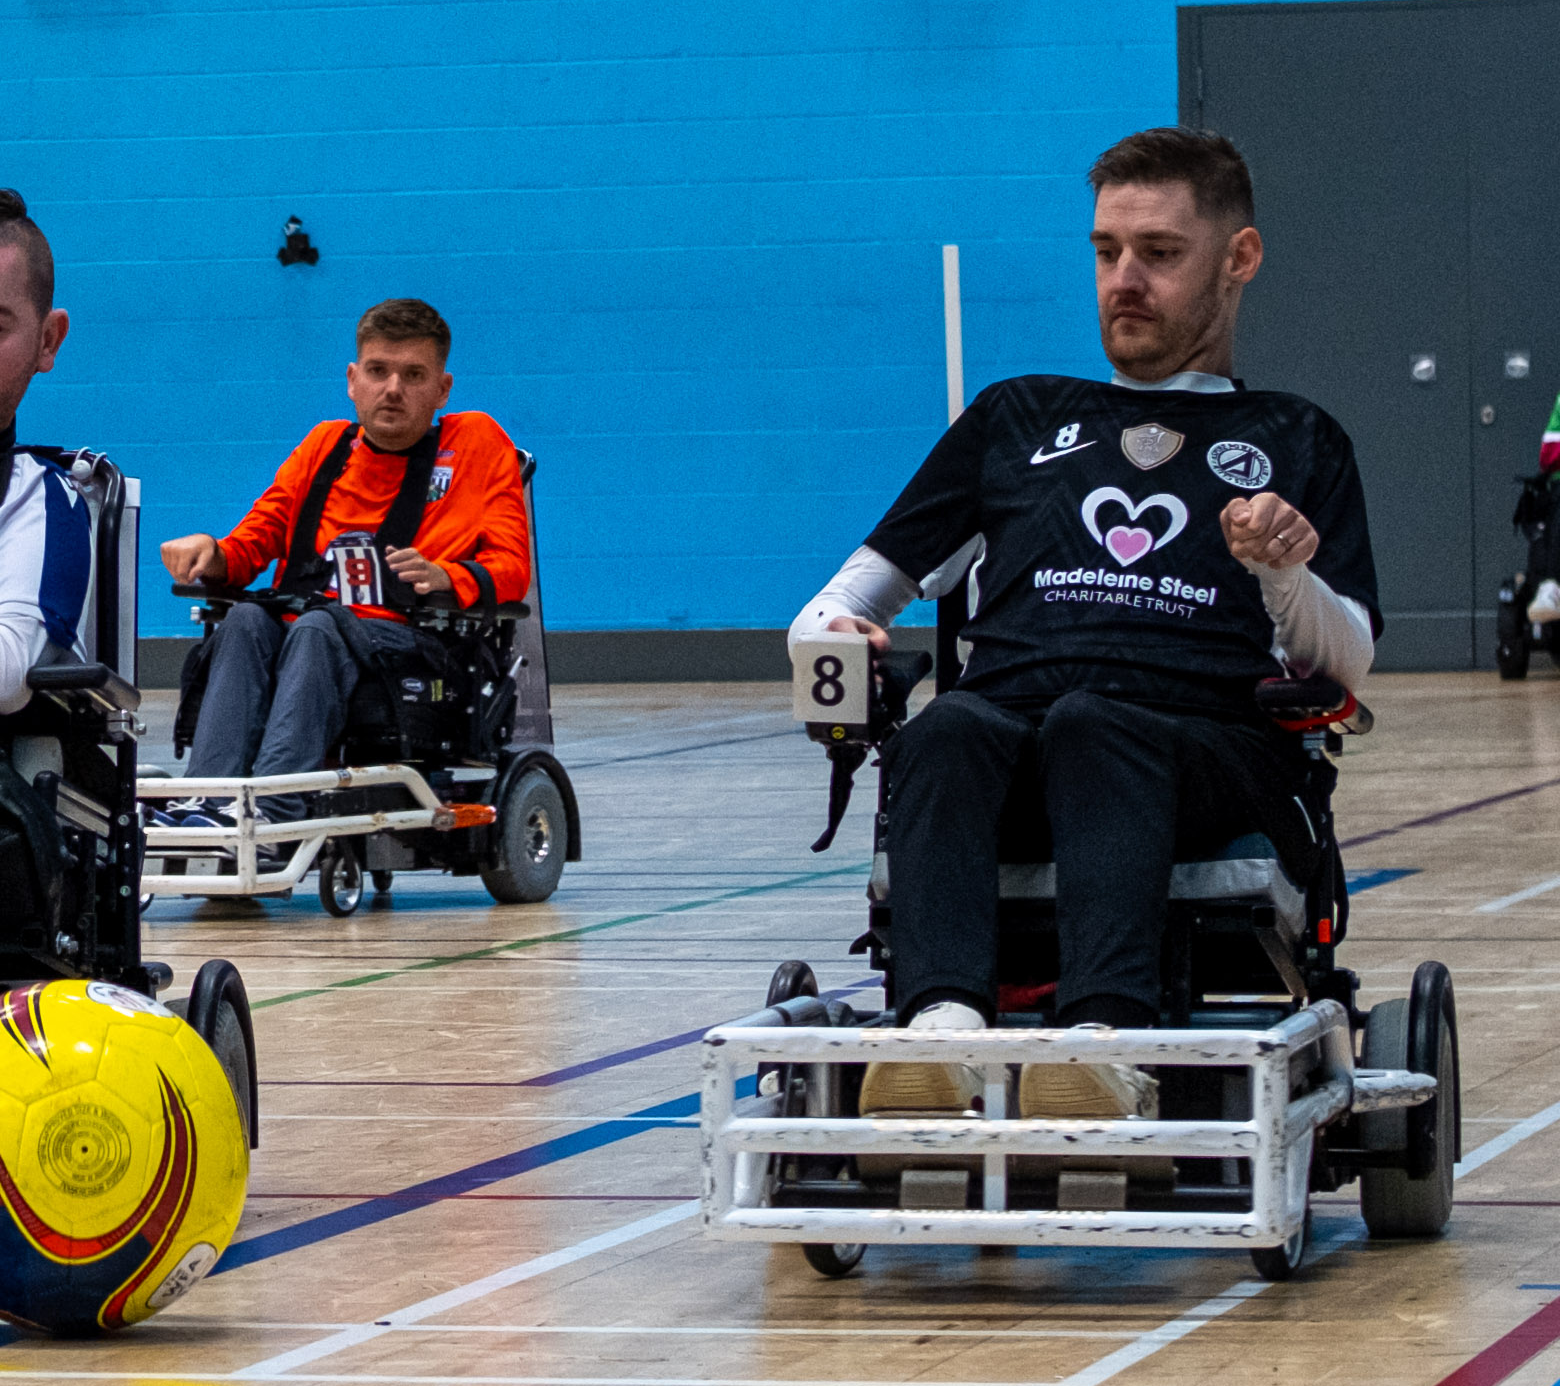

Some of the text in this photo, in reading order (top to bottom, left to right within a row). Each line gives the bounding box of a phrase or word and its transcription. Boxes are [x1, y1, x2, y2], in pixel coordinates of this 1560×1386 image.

[1055, 423, 1081, 448] 8
[345, 558, 372, 586] 9
[1034, 568, 1218, 606] Madeleine Steel
[1044, 590, 1198, 620] CHARITABLE TRUST
[811, 654, 845, 707] 8
